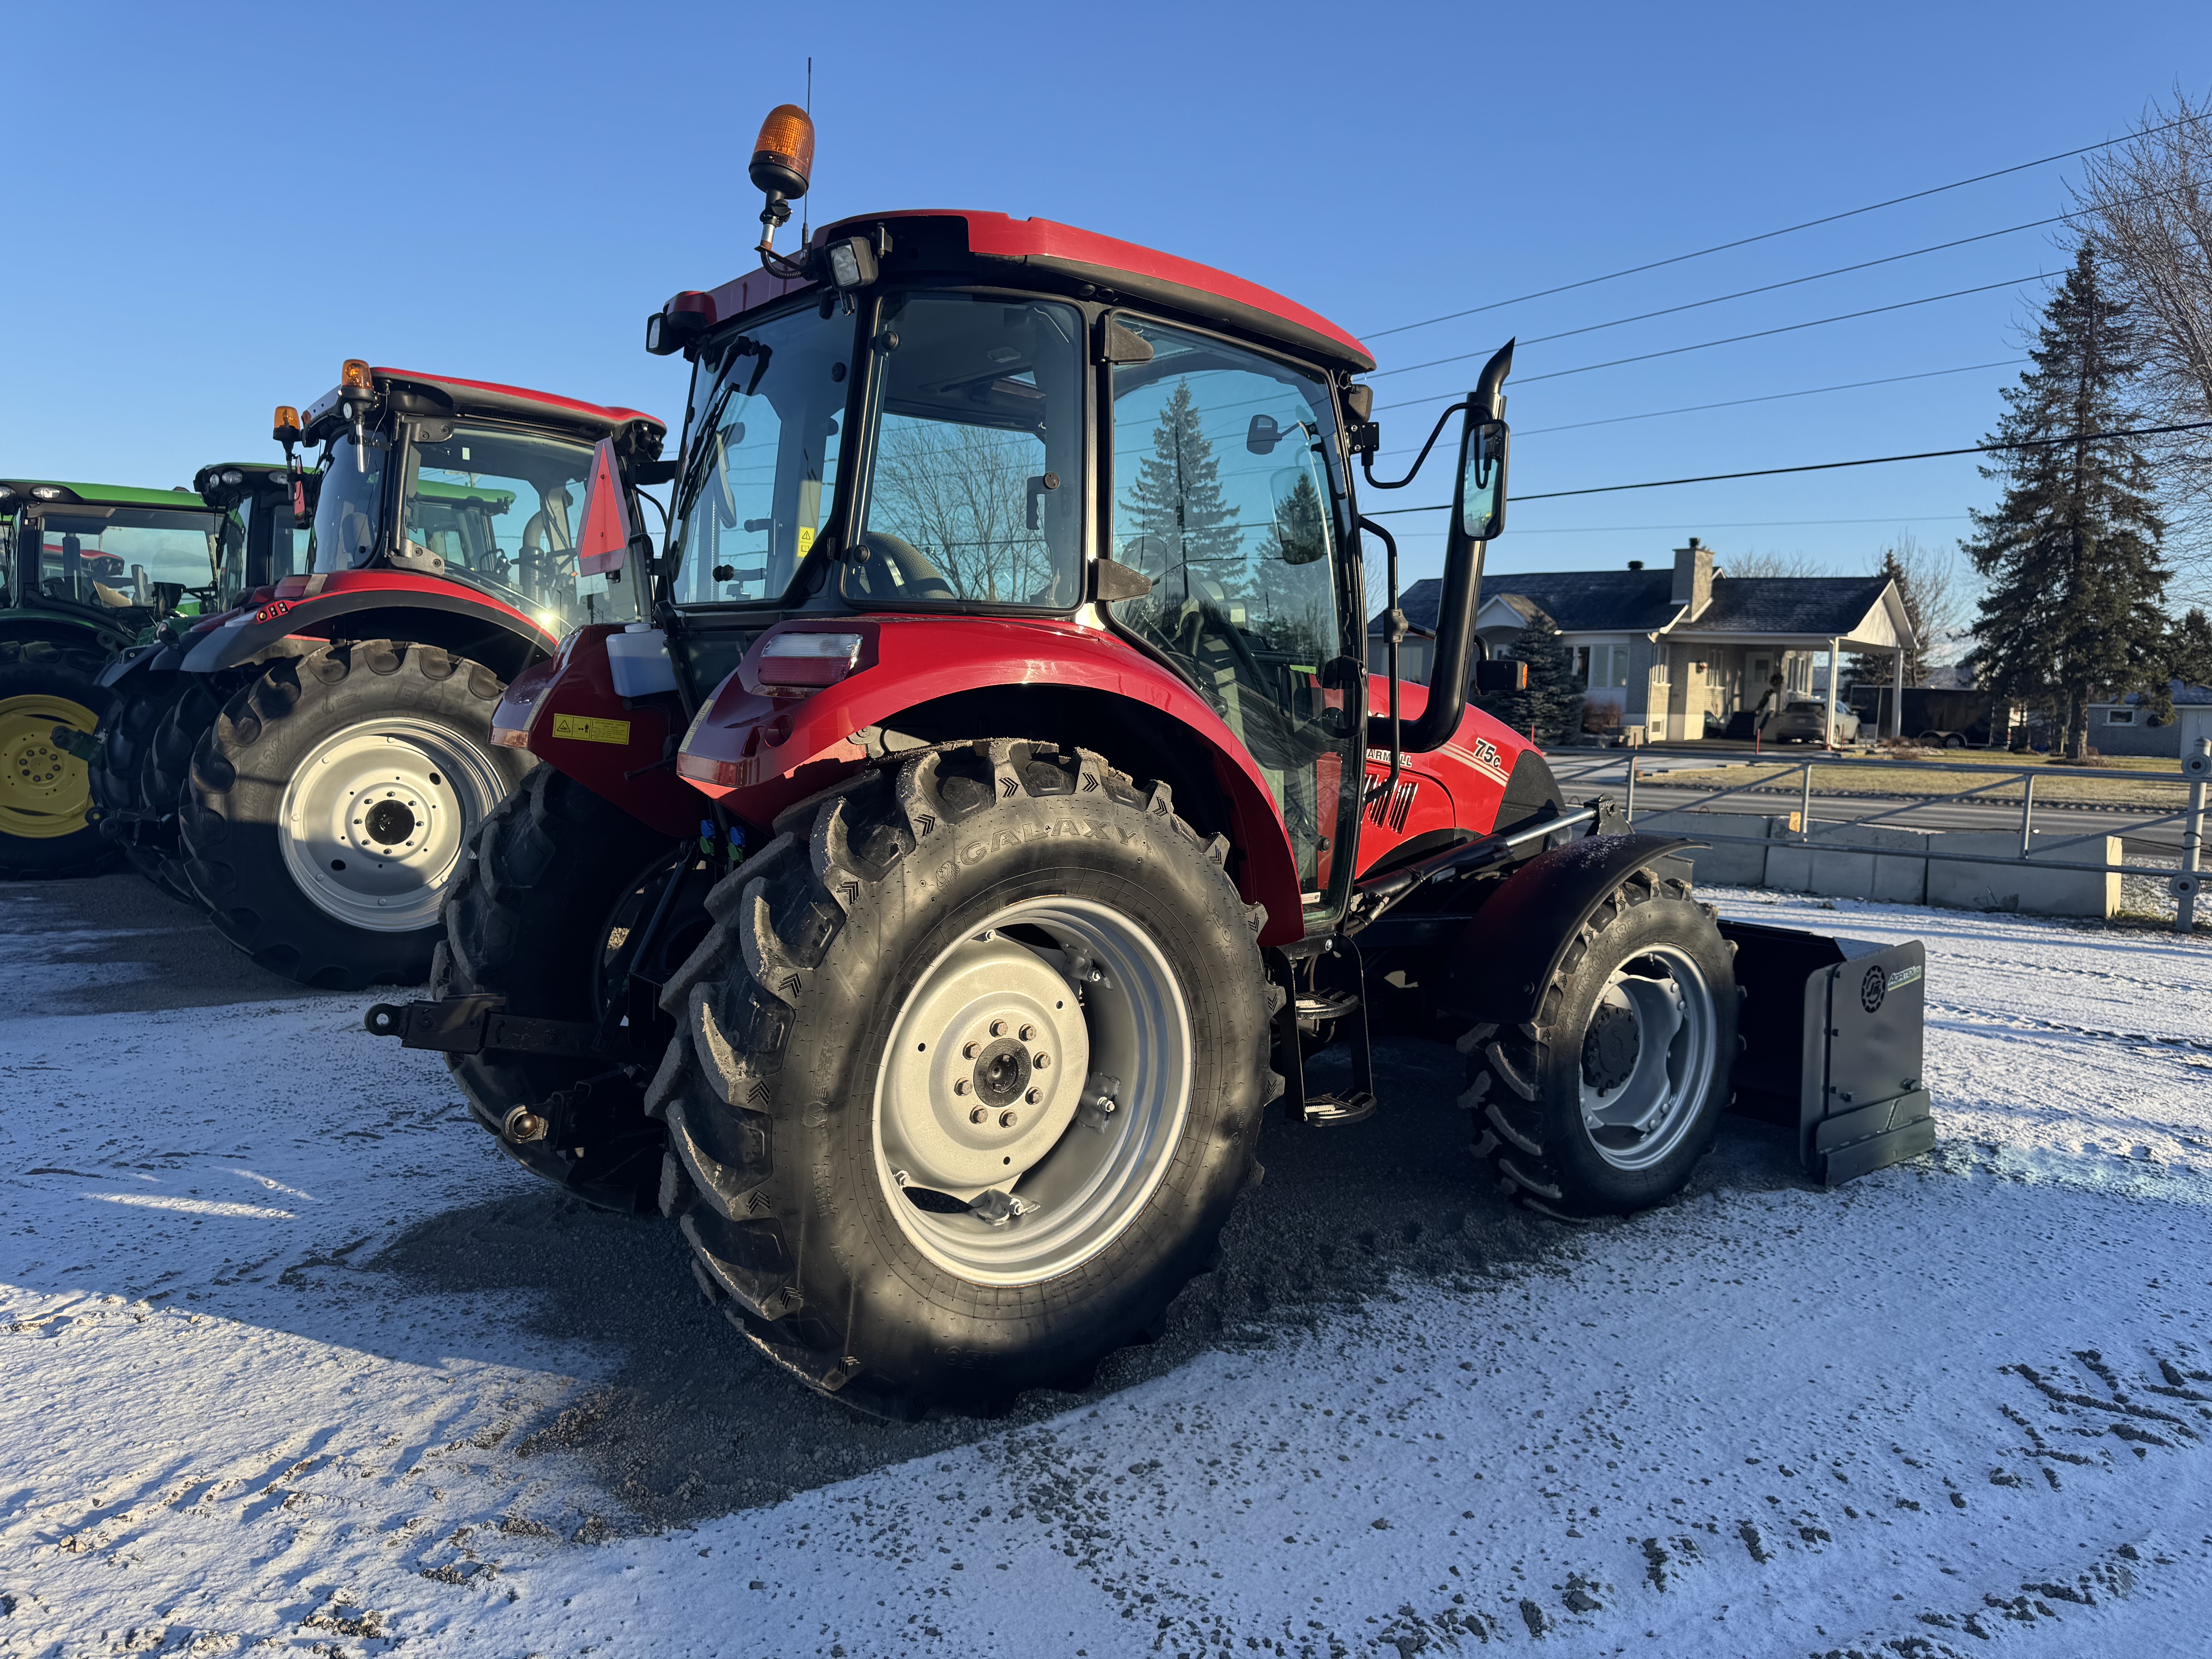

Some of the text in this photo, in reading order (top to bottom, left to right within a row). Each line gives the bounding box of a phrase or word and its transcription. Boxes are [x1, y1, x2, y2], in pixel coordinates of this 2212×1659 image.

[1367, 749, 1412, 768] ARMLL
[960, 818, 1139, 865] GALAXY
[1616, 912, 1647, 939] 850
